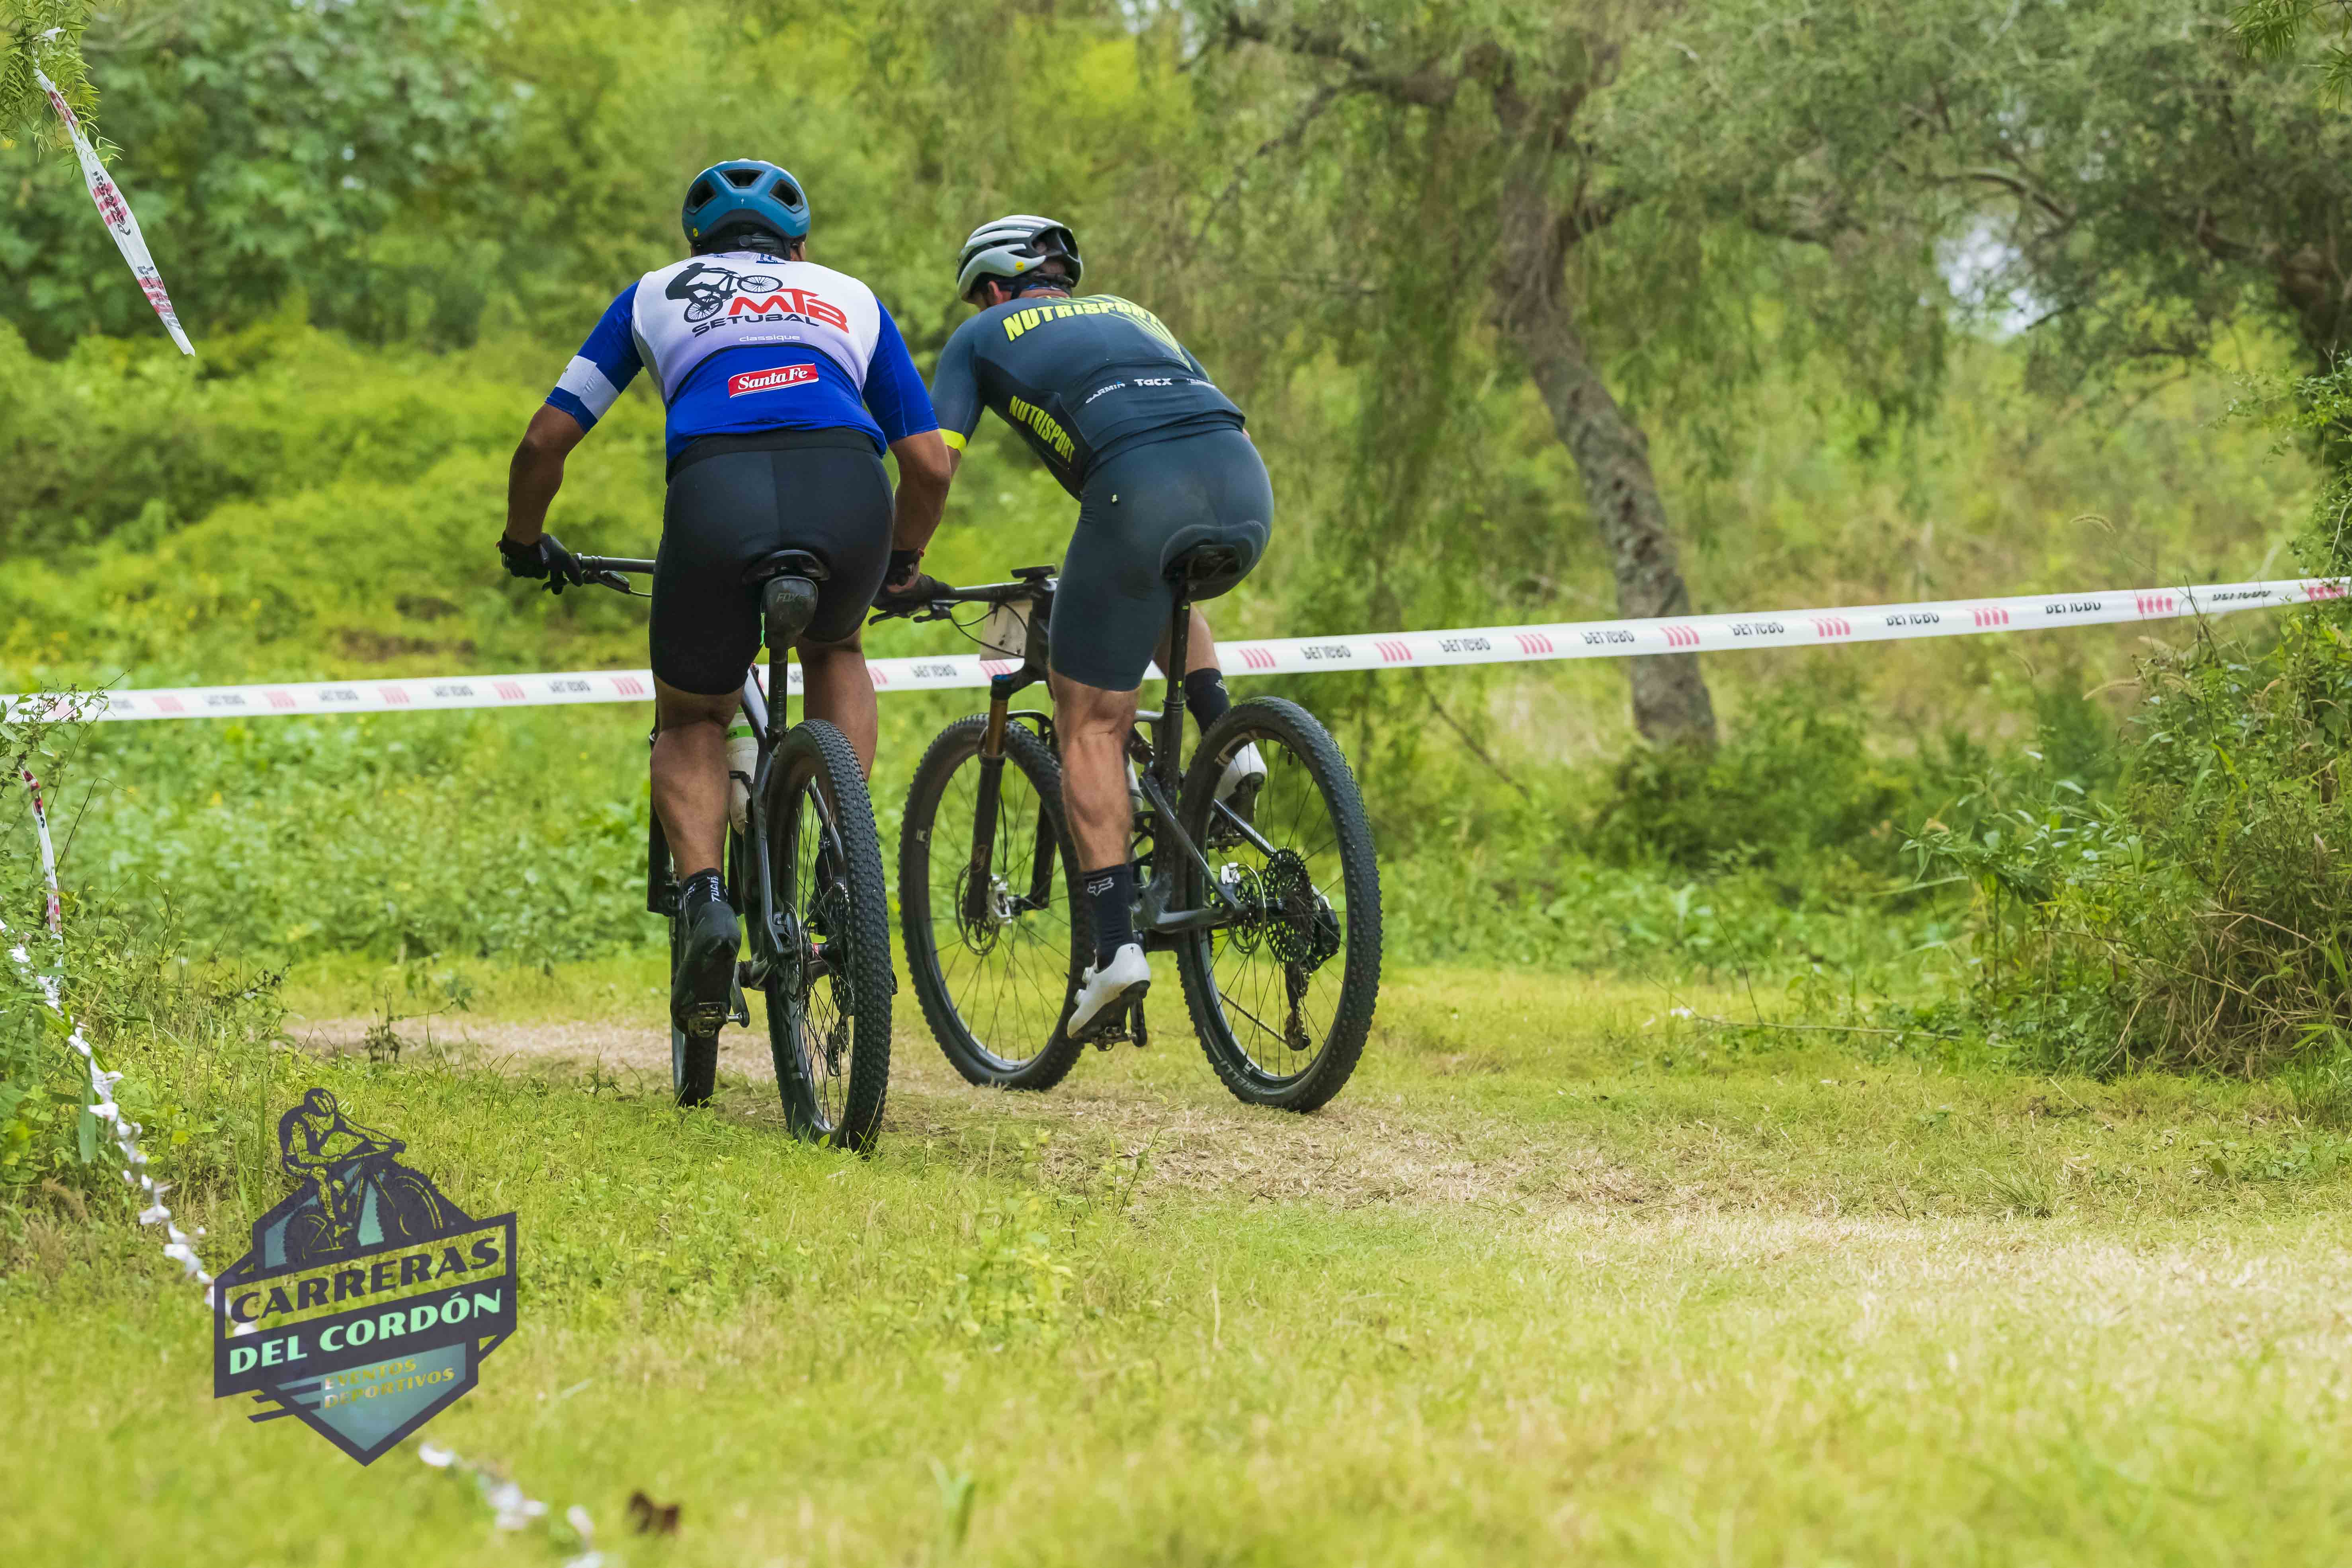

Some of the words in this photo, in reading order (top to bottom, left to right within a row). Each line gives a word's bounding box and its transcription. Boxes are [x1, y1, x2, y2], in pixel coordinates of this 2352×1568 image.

[692, 313, 820, 338] SETUBAL
[729, 288, 849, 334] MTB
[1002, 302, 1159, 342] NUTRISPORT
[738, 371, 786, 390] Santa
[787, 367, 808, 382] Fe
[1086, 382, 1125, 404] GARMIN
[1009, 395, 1075, 463] NUTRISPORT
